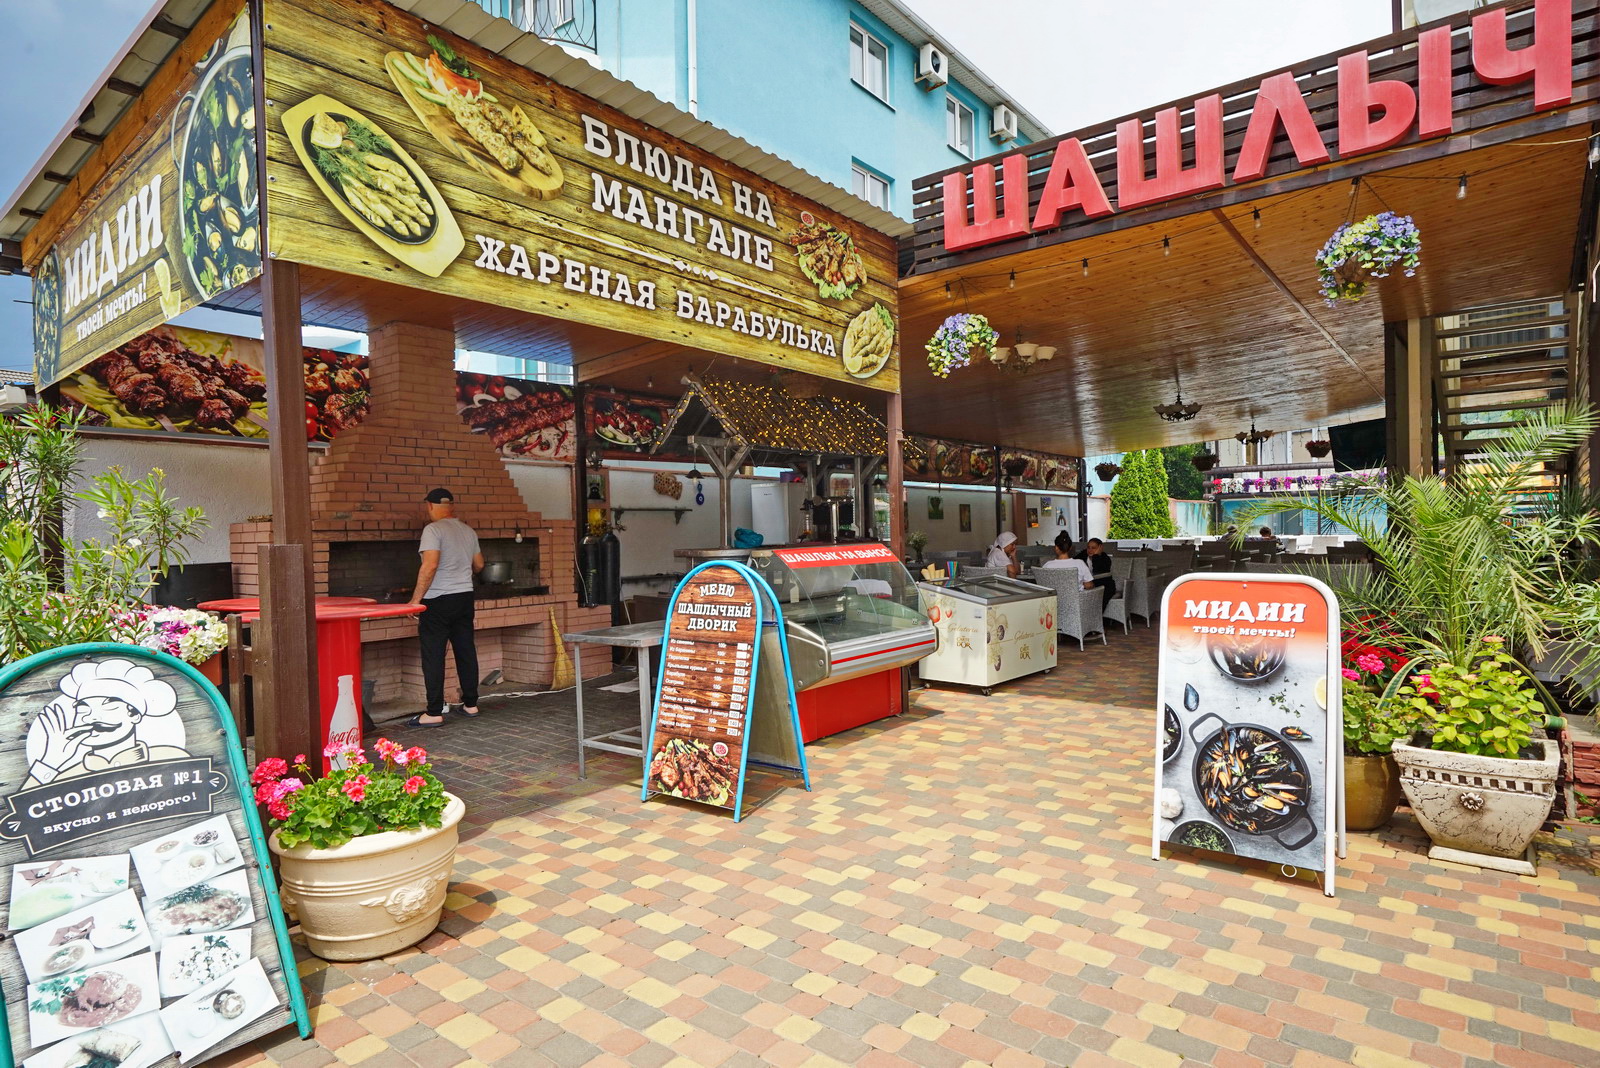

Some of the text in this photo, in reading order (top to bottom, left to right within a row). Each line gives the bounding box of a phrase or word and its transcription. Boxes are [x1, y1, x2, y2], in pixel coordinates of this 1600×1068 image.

[942, 0, 1572, 253] ШАШЛЫЧ
[581, 114, 777, 228] БЛЮДА НА
[591, 172, 774, 271] МАНГАЛЕ
[64, 174, 163, 314] МИДИИ
[76, 272, 147, 341] твоей мечты!
[474, 235, 837, 358] ЖАРЕНАЯ БАРАБУЛЬКА
[781, 551, 841, 563] ШАШЛЫК
[857, 548, 892, 559] ВЫНОС
[677, 602, 752, 618] ШАШЛЫЧНЫЙ
[700, 583, 735, 597] МЕНЮ
[1183, 599, 1307, 624] МИДИИ
[687, 617, 738, 632] ДВОРИК
[1192, 624, 1296, 639] твоей мечты!
[27, 774, 164, 819] СТОЛОВАЯ
[43, 791, 197, 835] вкусно и недорого!
